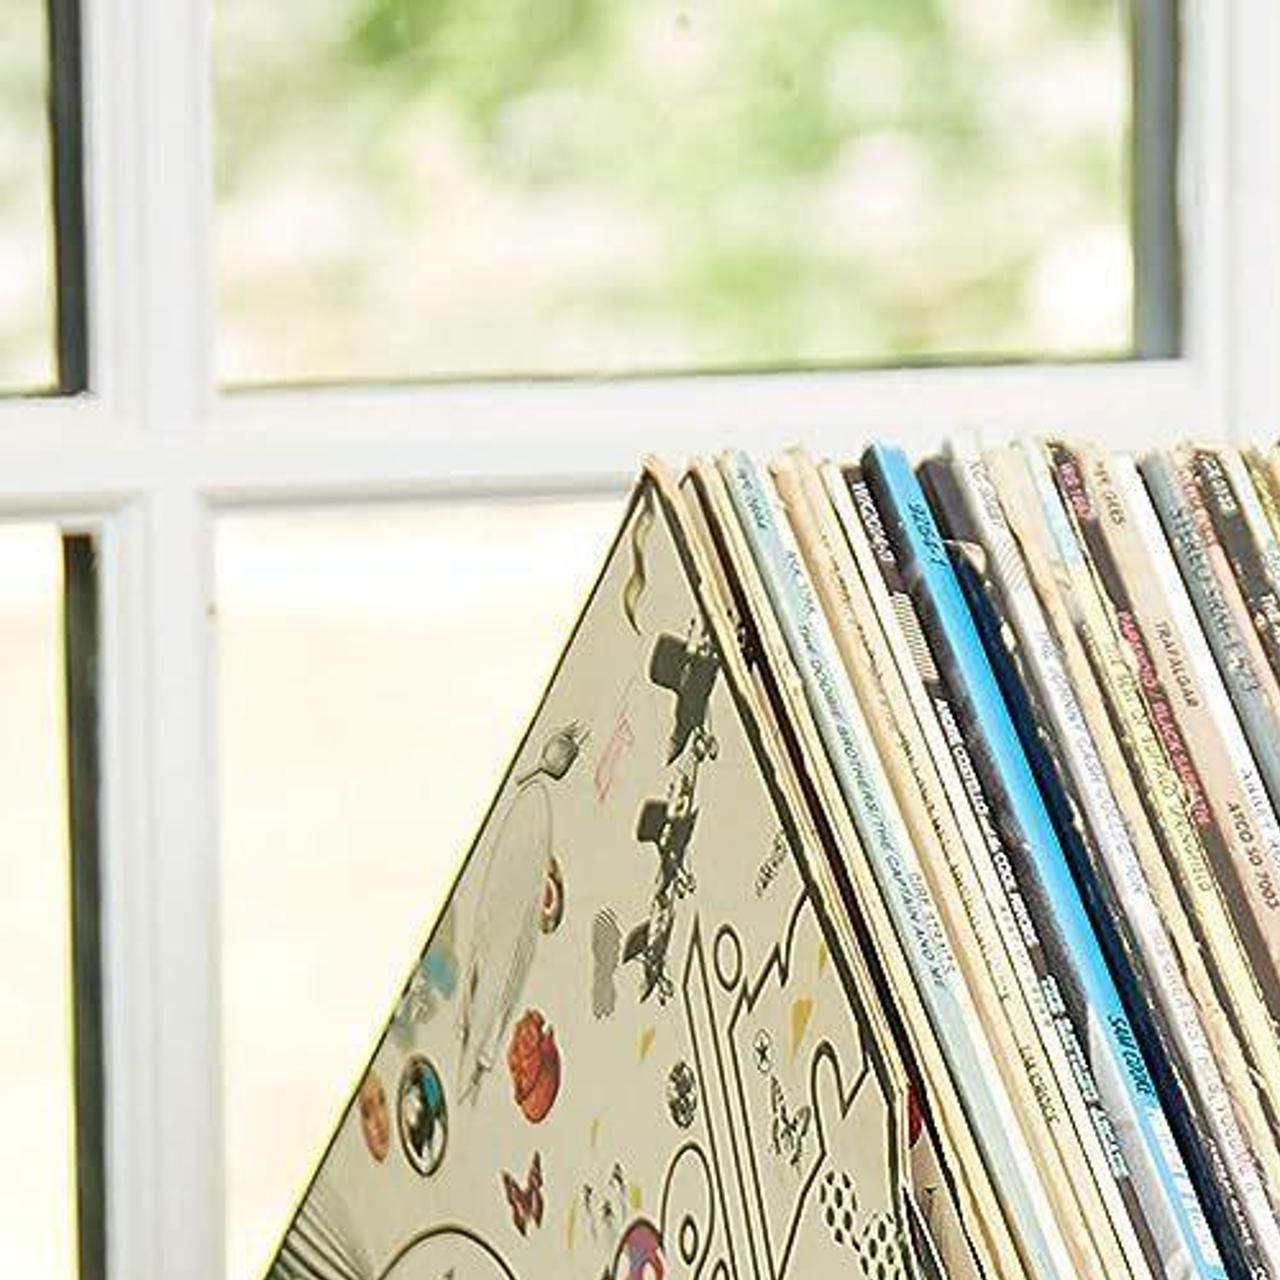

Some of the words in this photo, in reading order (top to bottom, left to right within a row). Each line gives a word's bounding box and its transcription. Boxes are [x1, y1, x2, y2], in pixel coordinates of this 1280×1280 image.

[1151, 620, 1202, 707] TRAFALGAR
[1224, 801, 1256, 842] ATCO
[881, 855, 923, 922] CAPTAIN
